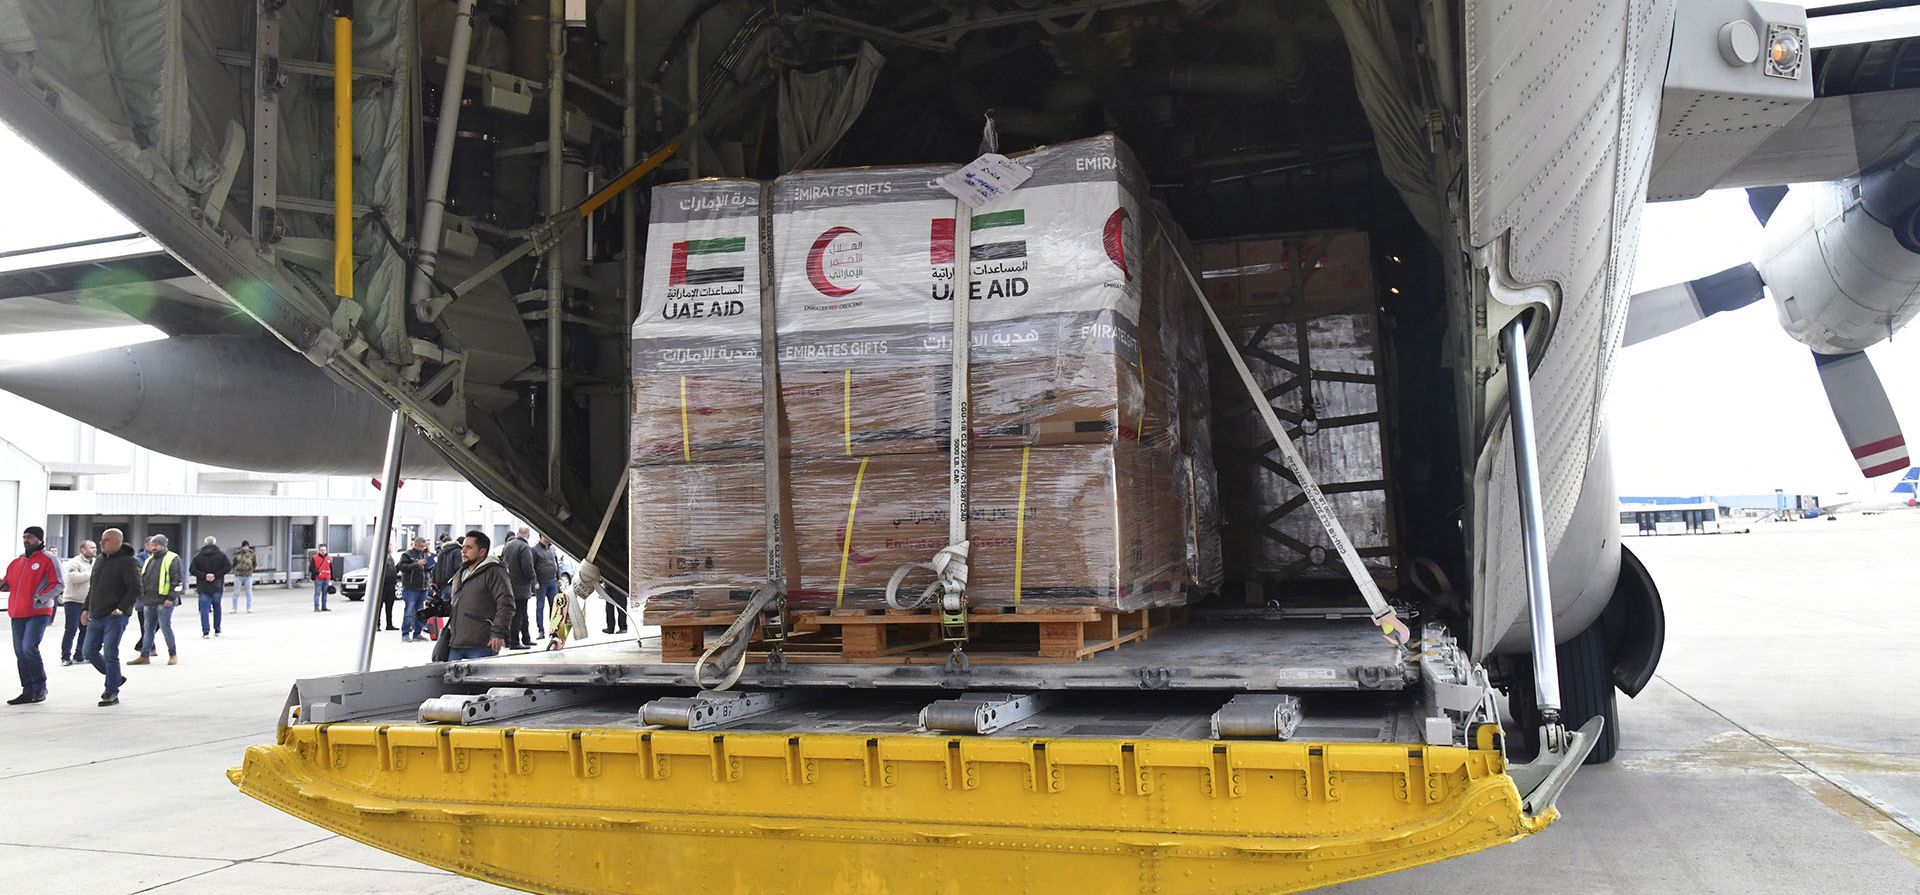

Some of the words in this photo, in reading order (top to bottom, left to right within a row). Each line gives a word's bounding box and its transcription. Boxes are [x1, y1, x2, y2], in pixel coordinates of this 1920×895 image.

[855, 181, 892, 195] GIFTS
[680, 194, 728, 212] الإمارات
[732, 192, 759, 208] دية
[973, 260, 1028, 275] المساعدات
[667, 287, 699, 301] الإماراتية
[699, 284, 744, 298] المساعدات
[932, 282, 982, 301] UE
[987, 277, 1029, 300] AID
[663, 302, 705, 320] UAE
[707, 300, 744, 318] AID
[992, 329, 1039, 347] هدية
[663, 347, 716, 364] الإمارات
[719, 345, 757, 362] هدية
[785, 343, 848, 360] EMIRATES
[850, 340, 888, 356] GIFTS
